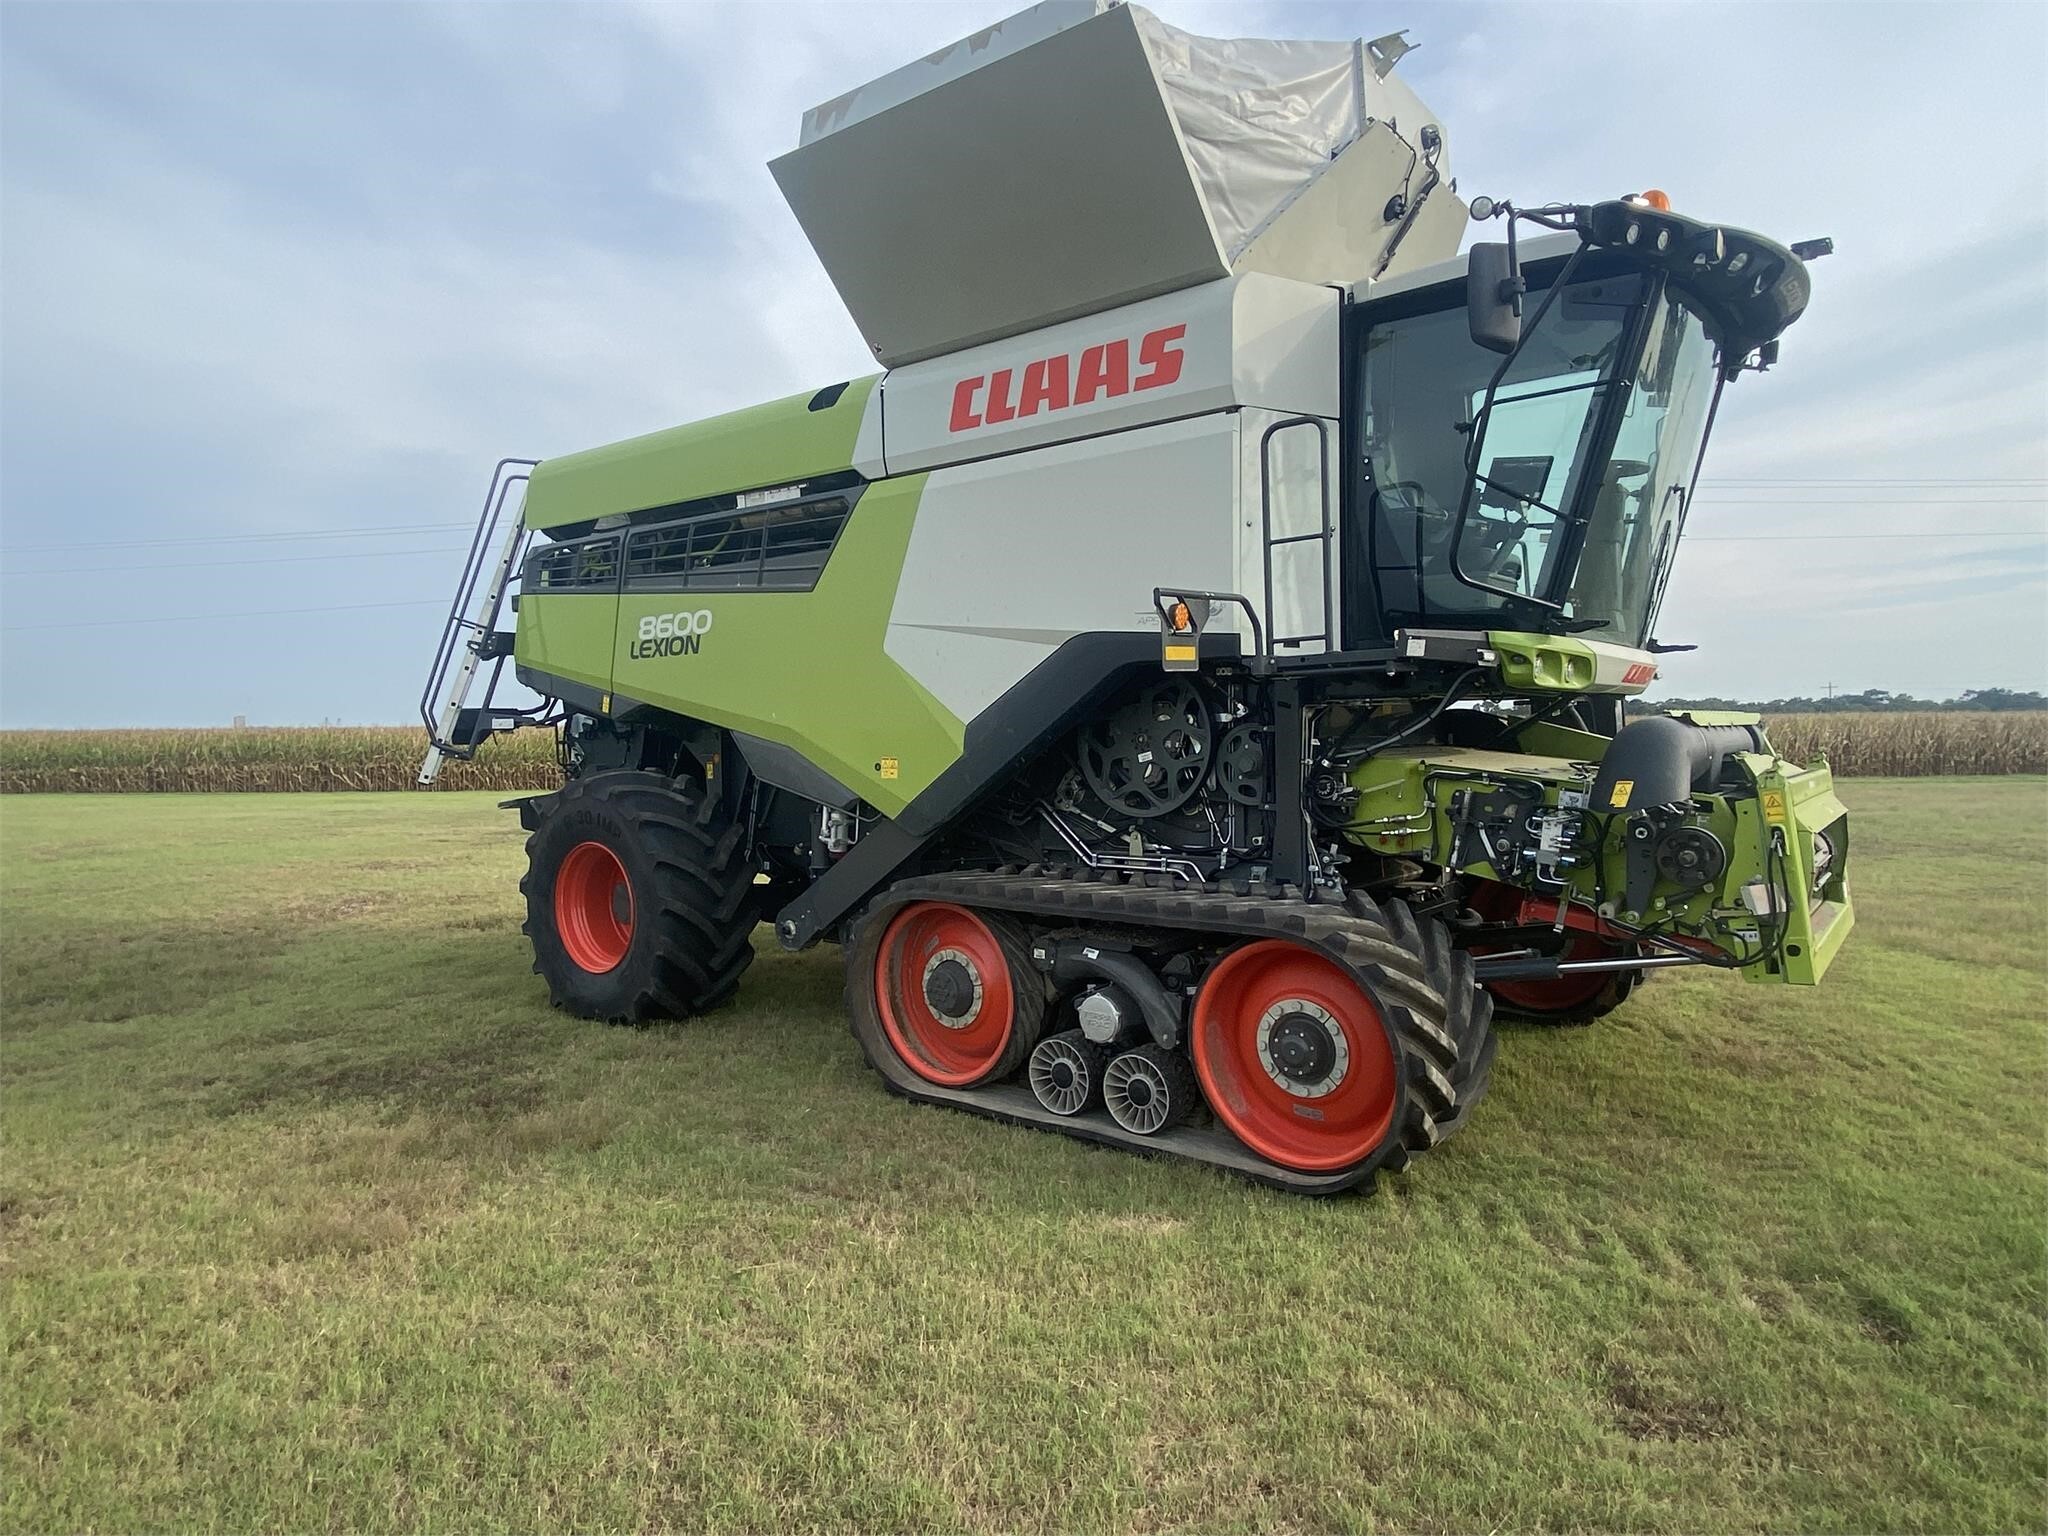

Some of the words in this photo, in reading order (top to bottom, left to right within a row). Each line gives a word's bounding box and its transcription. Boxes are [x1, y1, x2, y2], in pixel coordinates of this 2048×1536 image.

[949, 323, 1187, 432] CLAAS
[638, 609, 713, 640] 8600
[630, 634, 701, 660] LEXION
